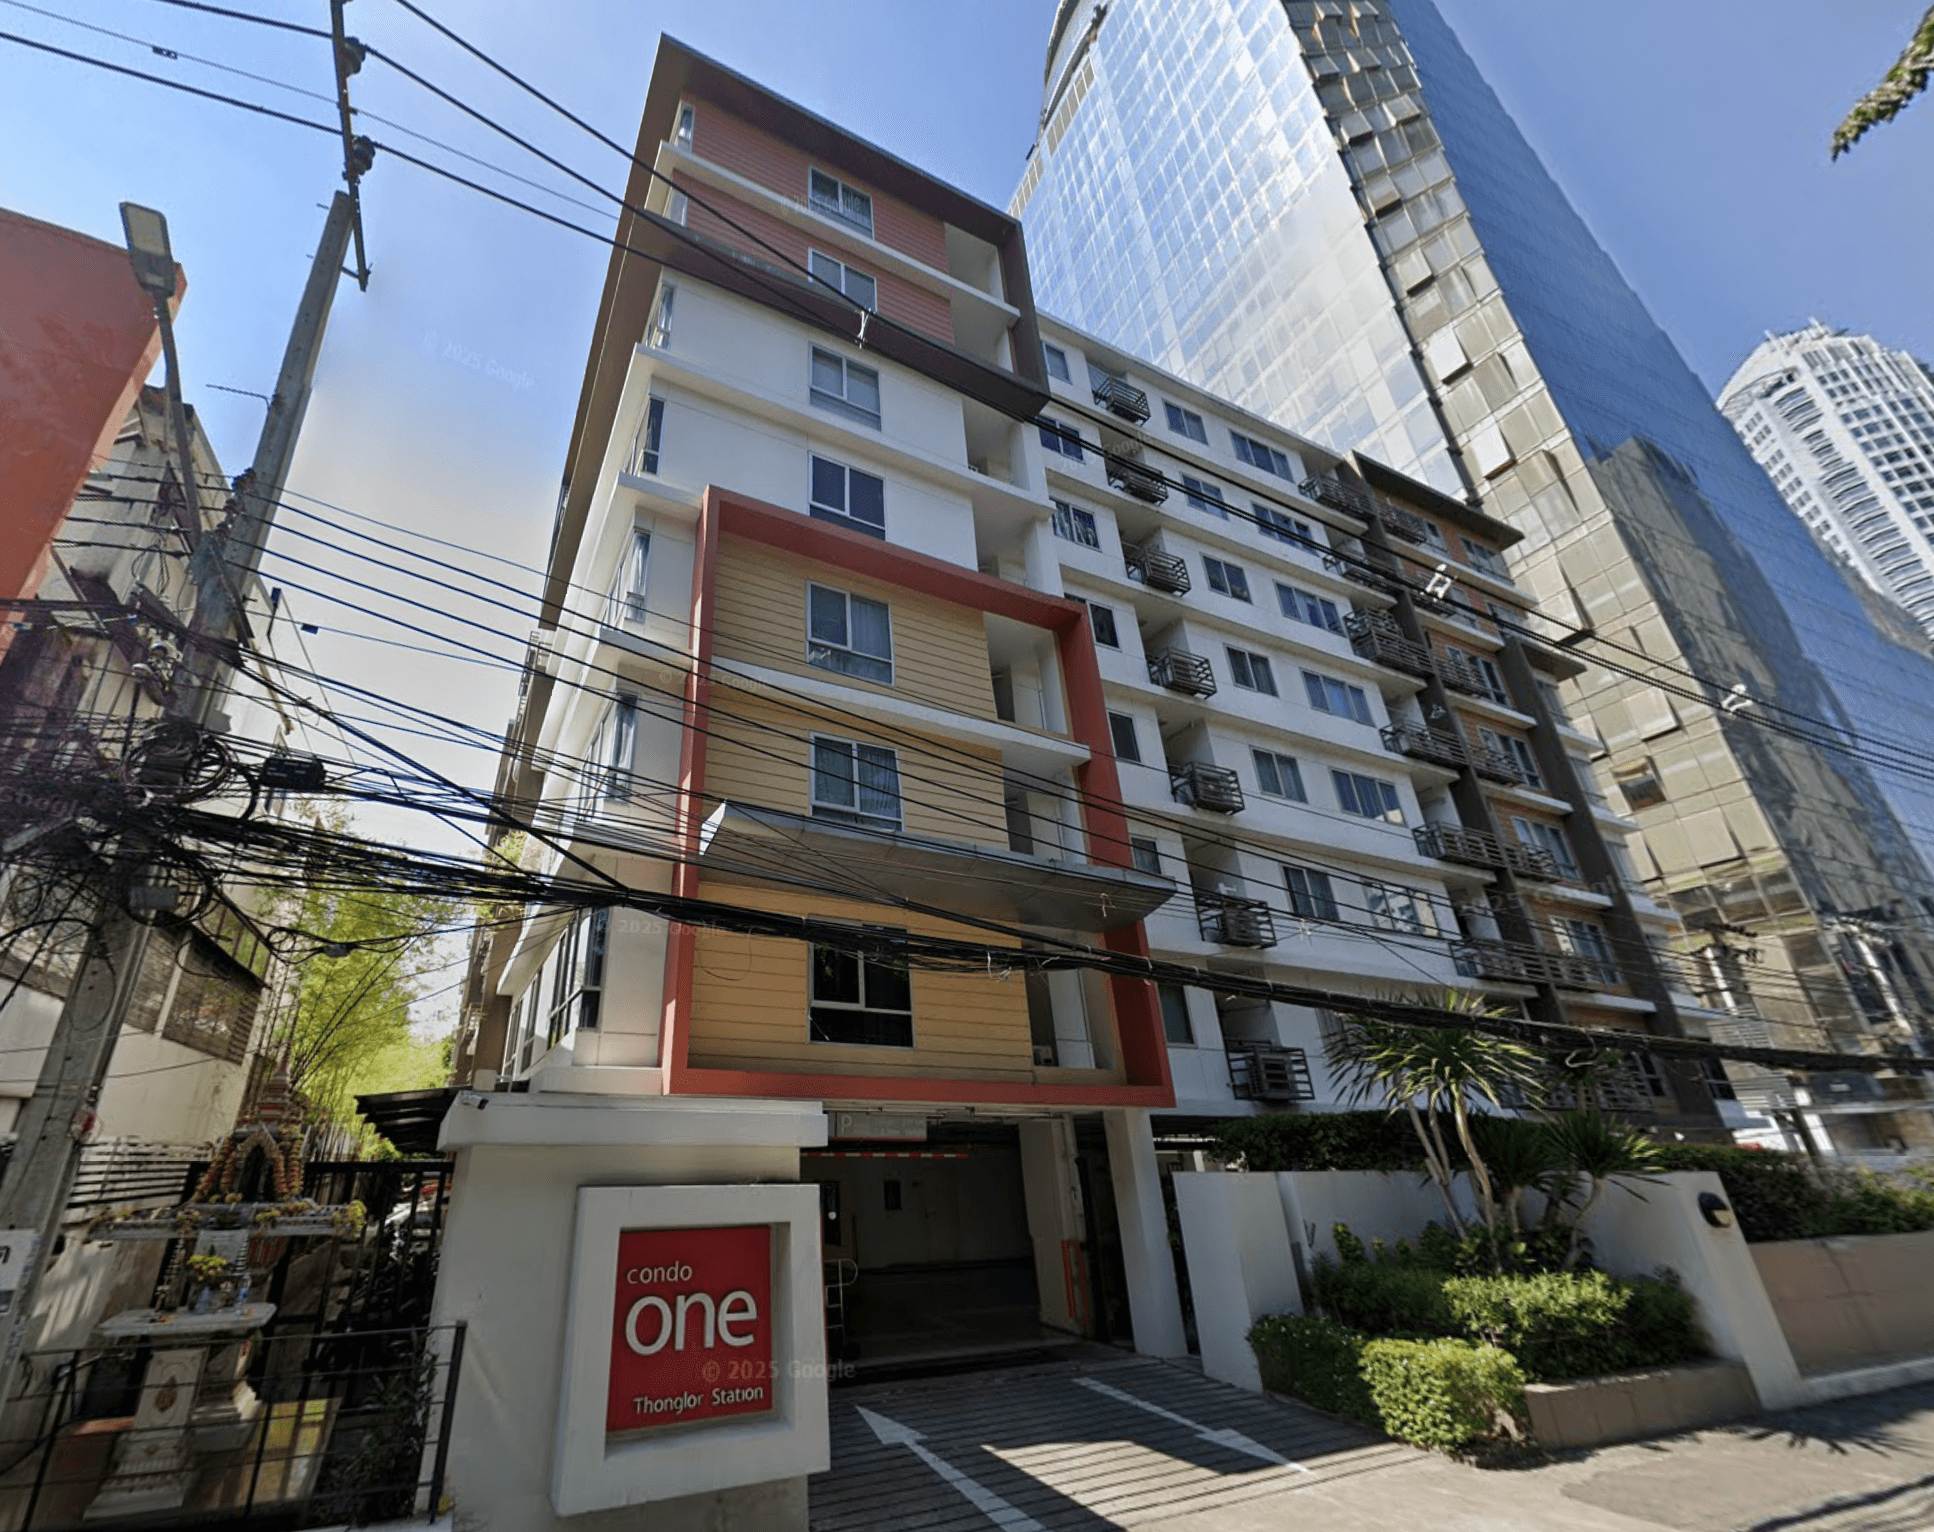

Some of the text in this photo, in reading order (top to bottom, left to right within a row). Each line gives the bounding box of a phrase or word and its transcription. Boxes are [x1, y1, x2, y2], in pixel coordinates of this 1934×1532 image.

[627, 1260, 693, 1285] condo
[625, 1289, 758, 1356] one
[634, 1385, 764, 1416] Thonglor Station
